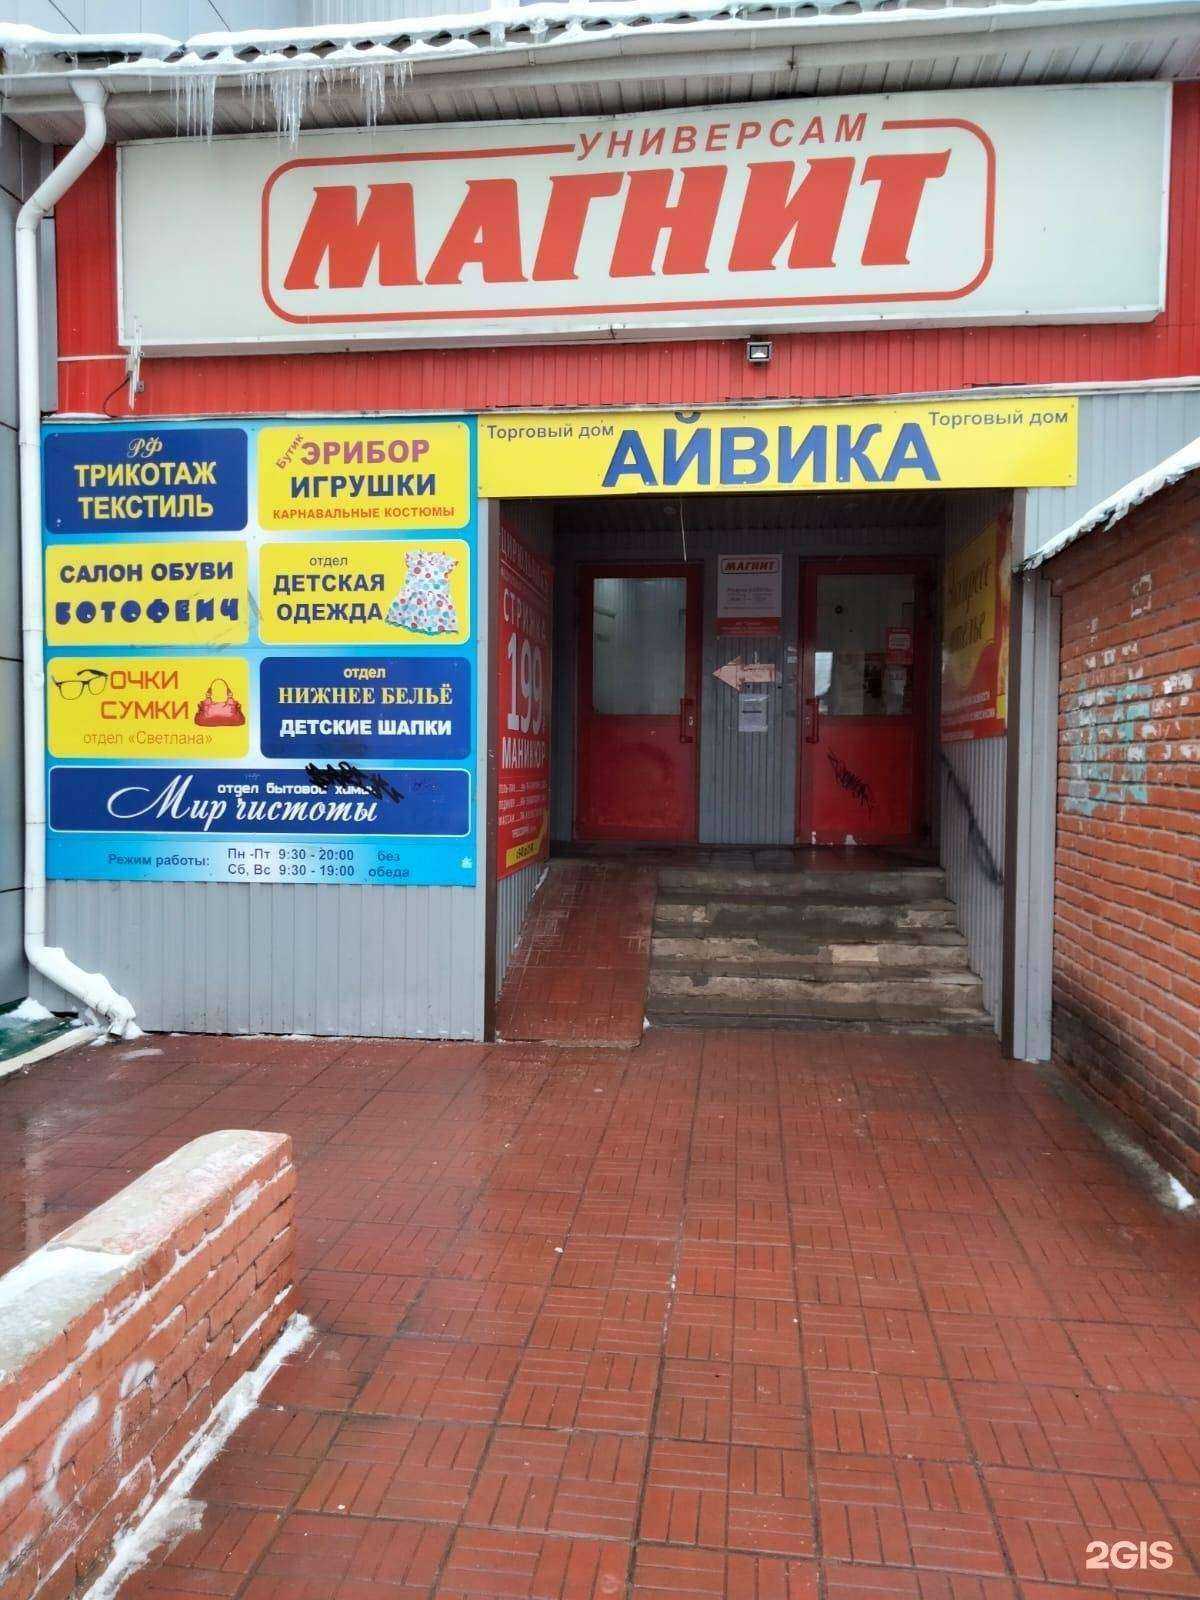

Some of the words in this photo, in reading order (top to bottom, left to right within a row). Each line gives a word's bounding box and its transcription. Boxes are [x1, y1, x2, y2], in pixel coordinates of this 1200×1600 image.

[577, 112, 868, 161] УНИВЕРСАМ
[283, 148, 952, 290] МАГНИТ
[928, 409, 1023, 428] Торговый
[1029, 410, 1068, 425] дом
[487, 424, 573, 442] Торговый
[578, 423, 614, 439] дом
[275, 433, 304, 470] Бутик
[300, 438, 430, 466] ЭРИБОР
[601, 411, 941, 487] АЙВИКА
[73, 461, 217, 488] ТРИКОТАЖ
[290, 473, 436, 499] ИГРУШКИ
[77, 494, 214, 520] ТЕКСТИЛЬ
[273, 507, 380, 520] КАРНАВАЛЬНЫЕ
[384, 506, 455, 518] КОСТЮМЫ
[309, 555, 348, 567] отдел
[724, 560, 776, 571] МАГНИТ
[60, 564, 143, 584] САЛОН
[151, 561, 233, 582] ОБУВИ
[273, 573, 385, 595] ДЕТСКАЯ
[276, 602, 383, 624] ОДЕЖДА
[109, 670, 179, 690] ОЧКИ
[343, 667, 387, 680] отдел
[278, 687, 376, 705] НИЖНЕЕ
[381, 683, 454, 705] БЕЛЬЁ
[100, 700, 189, 720] СУМКИ
[83, 731, 123, 745] отдел
[128, 730, 213, 745] «Светлана»
[279, 718, 373, 737] ДЕТСКИЕ
[378, 719, 452, 736] ШАПКИ
[217, 784, 259, 797] отдел
[107, 774, 227, 832] Мир
[235, 797, 378, 822] чистоты
[108, 853, 151, 865] Режим
[155, 854, 210, 868] работы:
[228, 848, 245, 860] Пн
[278, 848, 306, 861] 9:30
[319, 848, 354, 861] 20:00
[377, 850, 400, 862] без
[228, 863, 249, 877] Сб,
[254, 864, 271, 876] Вс
[278, 864, 306, 876] 9:30
[320, 864, 354, 877] 19:00
[368, 864, 409, 878] обеда
